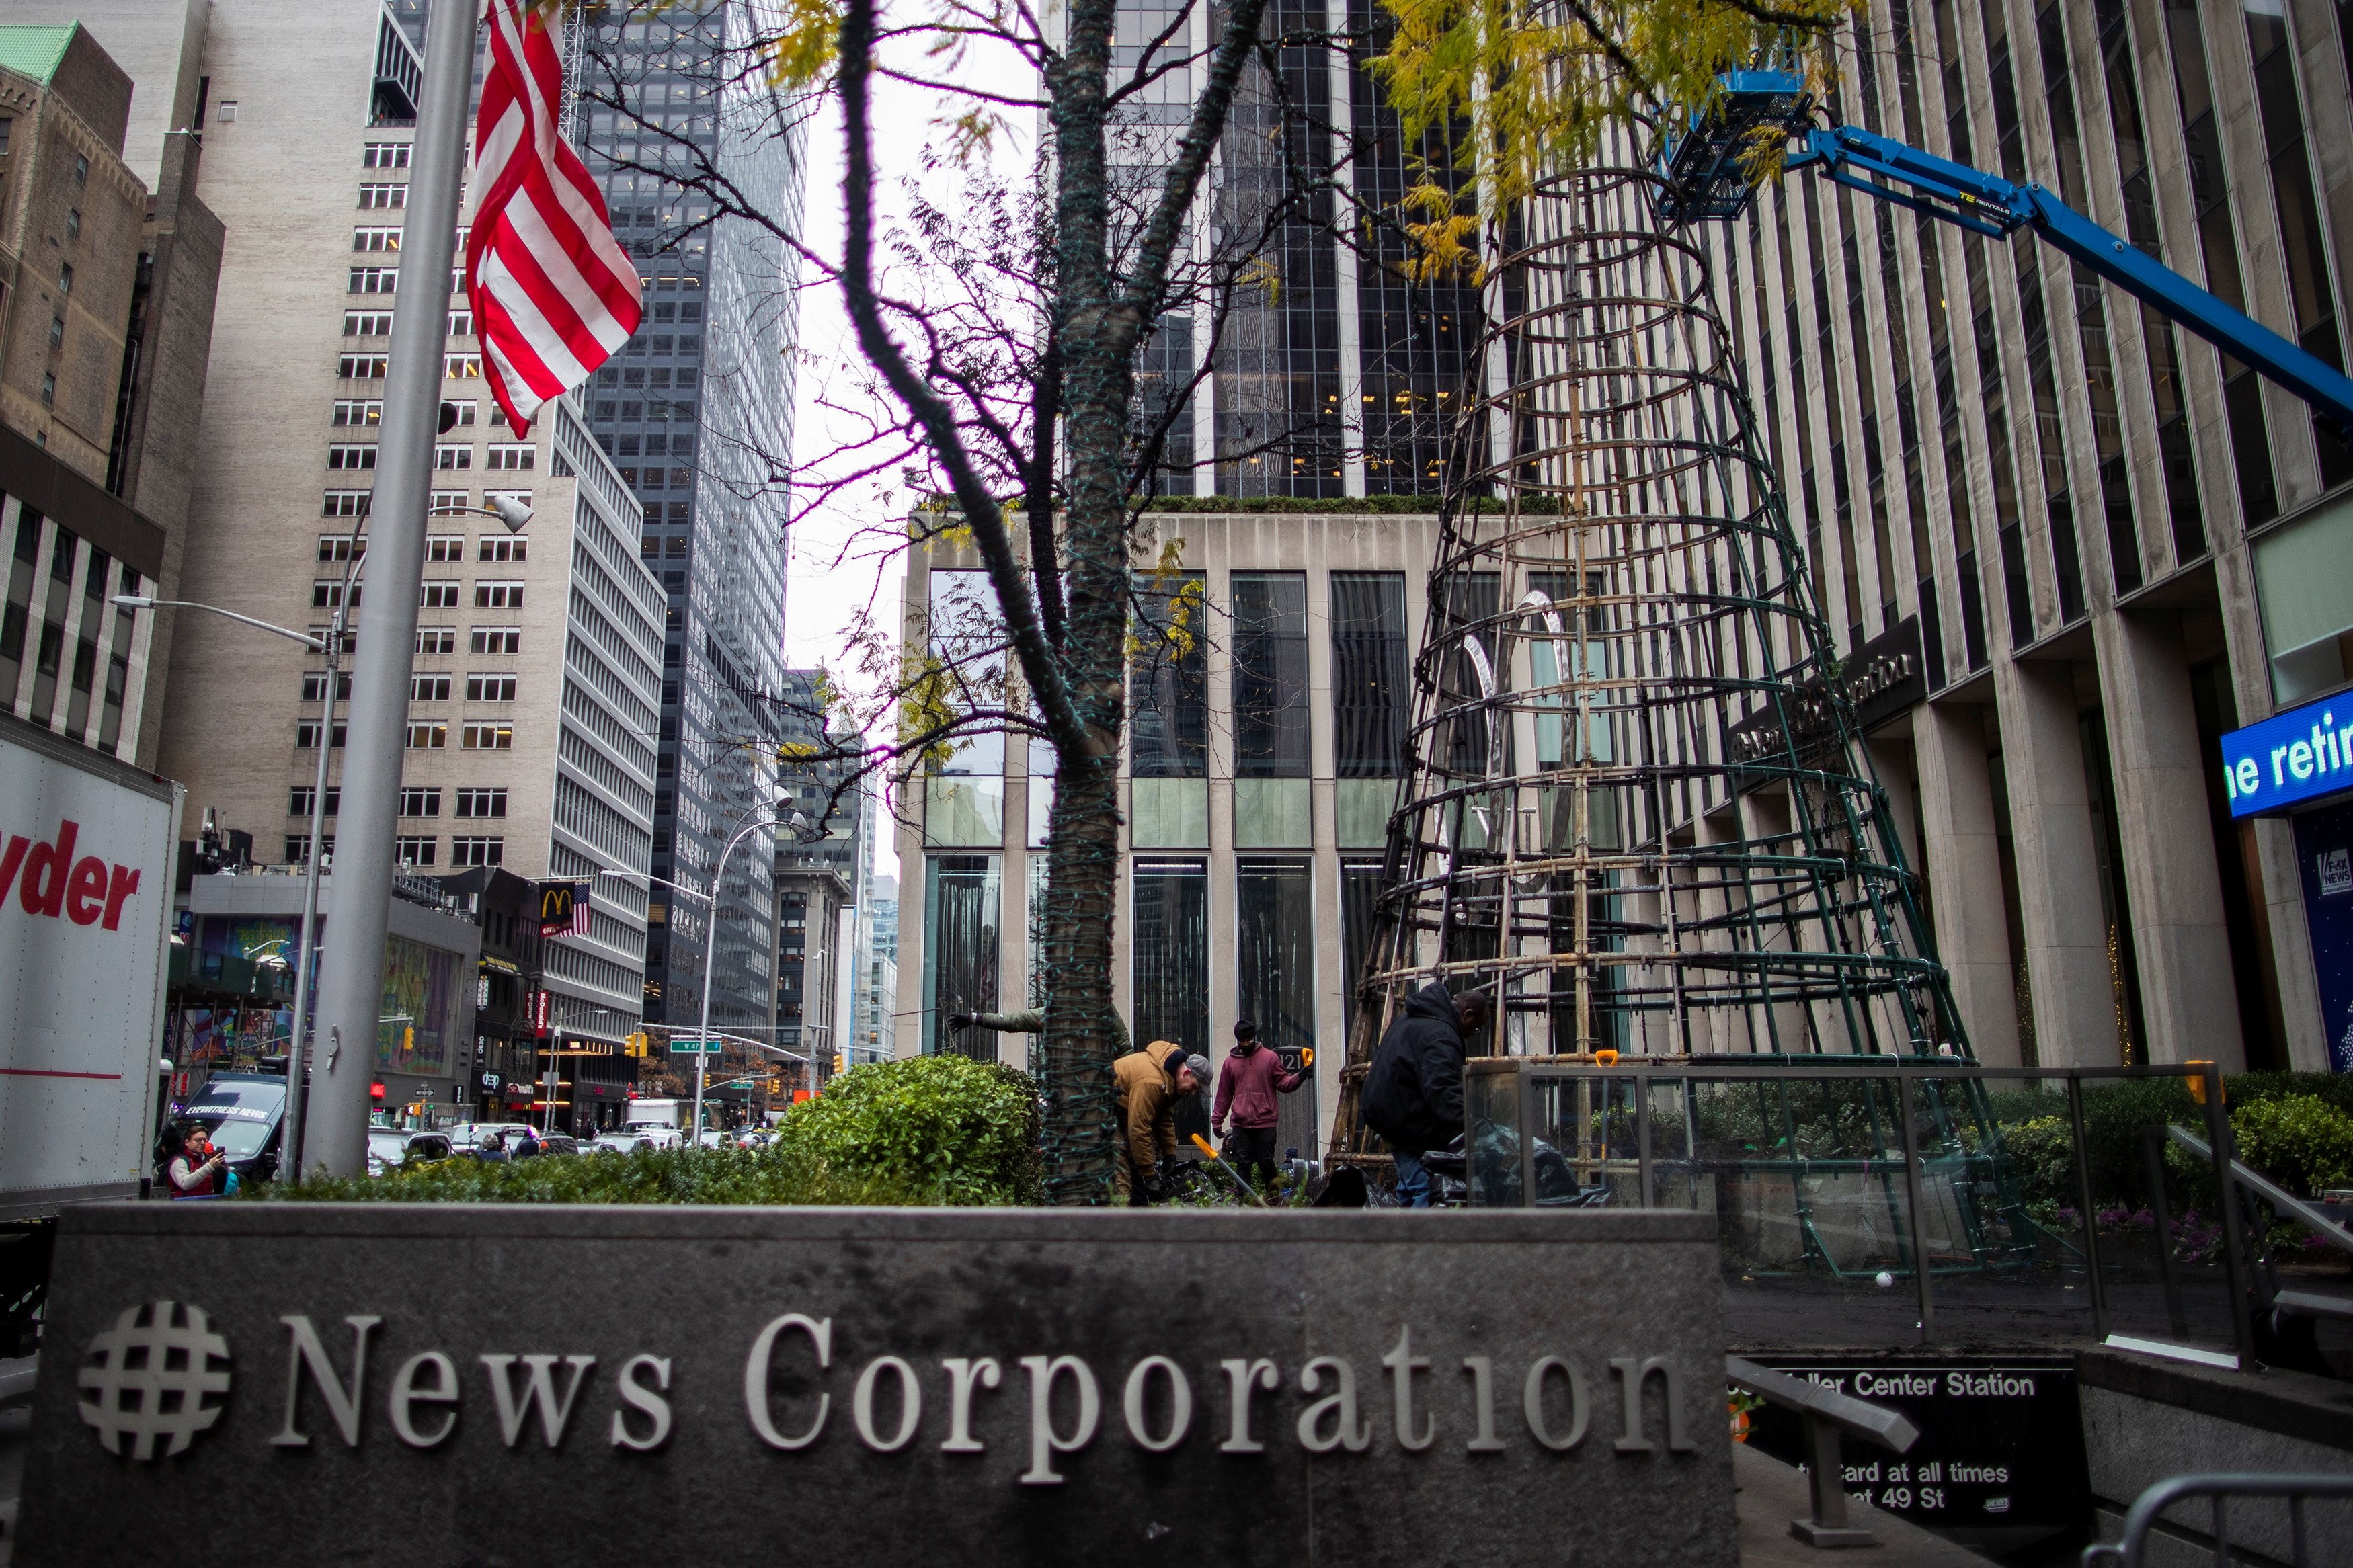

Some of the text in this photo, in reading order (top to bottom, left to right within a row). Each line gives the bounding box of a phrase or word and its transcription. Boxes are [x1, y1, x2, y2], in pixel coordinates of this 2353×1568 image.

[1959, 191, 2011, 214] TE RENTALS
[2328, 858, 2349, 873] FOX
[2324, 870, 2351, 885] NEWS
[2323, 883, 2352, 894] International
[538, 992, 546, 1029] McDonald's
[185, 1105, 268, 1120] EYEWITNESS NEWS
[1854, 1372, 1936, 1396] Center
[1947, 1372, 2035, 1396] Station
[270, 1312, 1700, 1483] News Corporation
[1888, 1463, 1910, 1482] at
[1918, 1462, 1940, 1482] all
[1949, 1462, 2009, 1483] times
[1882, 1487, 1911, 1508] 49
[1920, 1487, 1945, 1508] St
